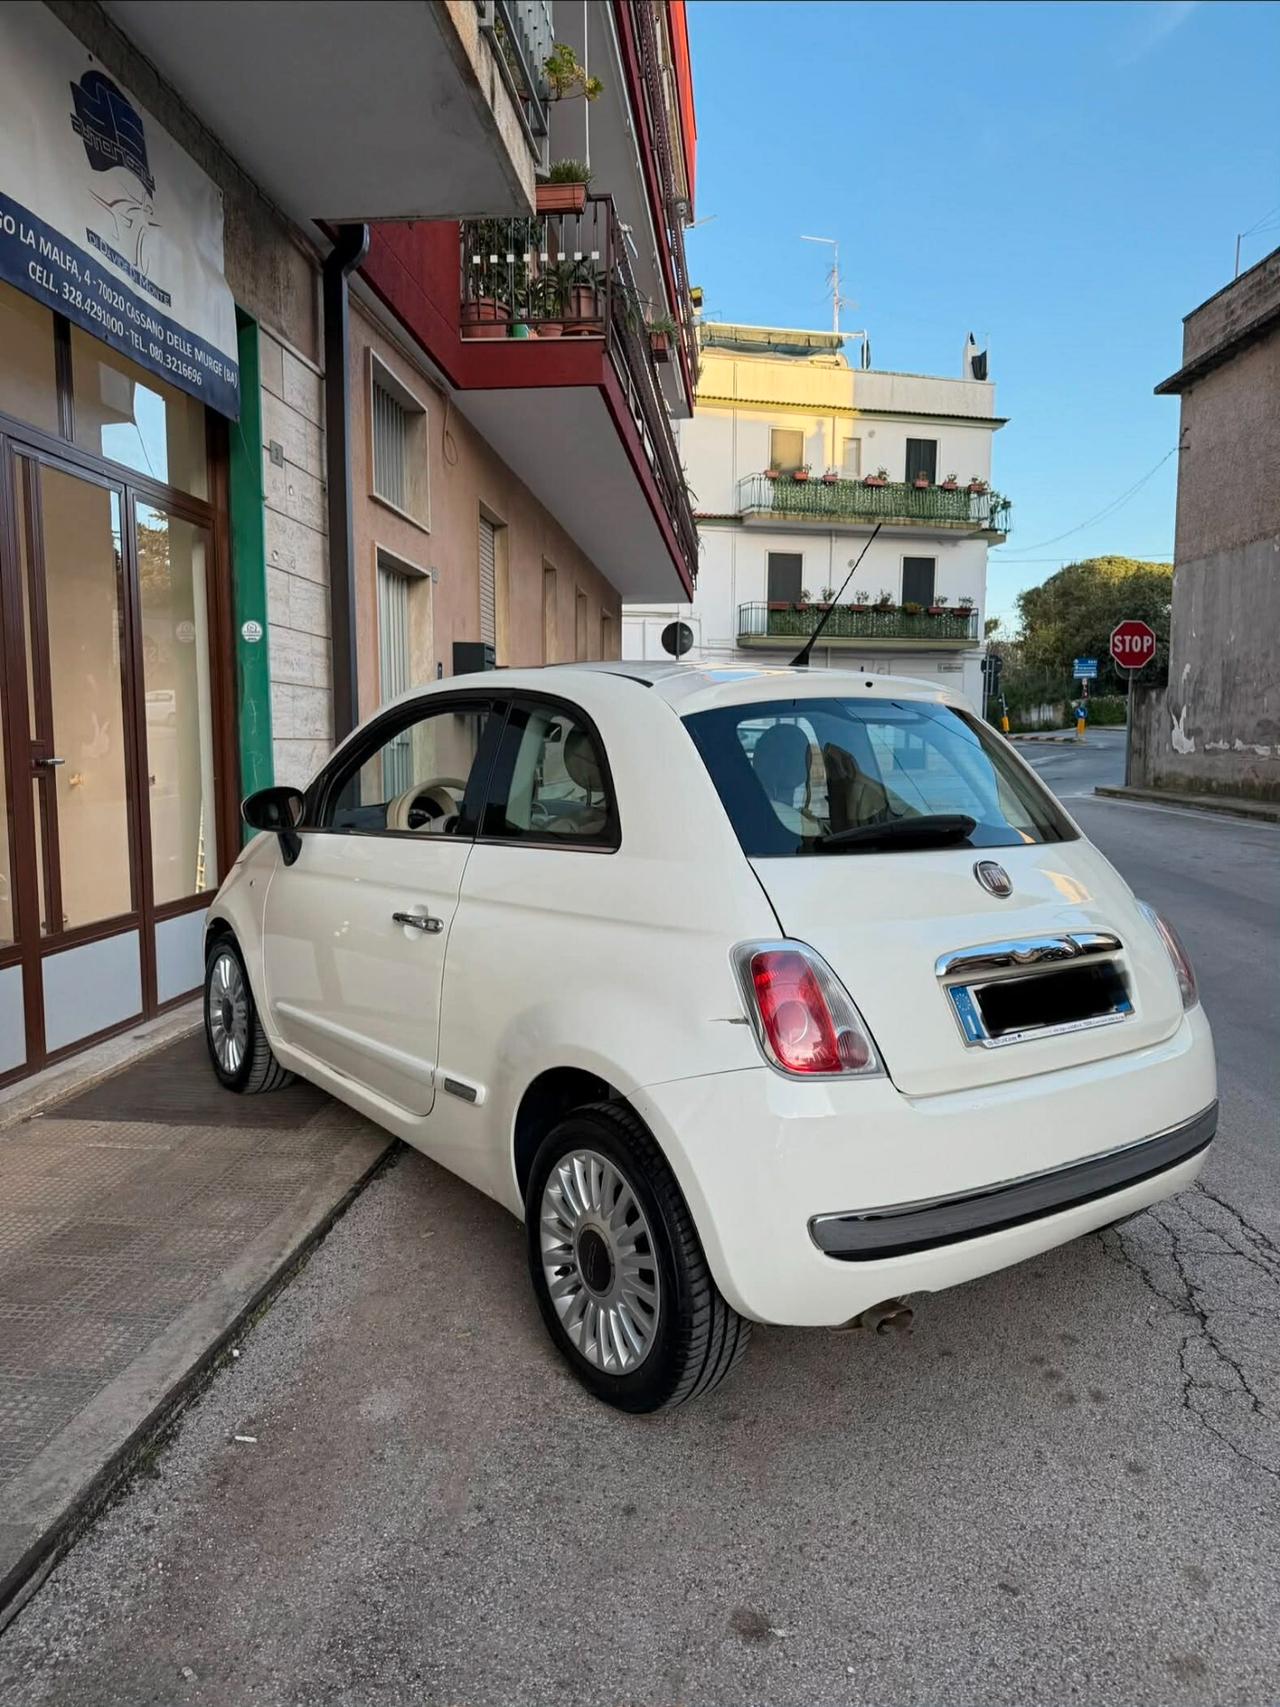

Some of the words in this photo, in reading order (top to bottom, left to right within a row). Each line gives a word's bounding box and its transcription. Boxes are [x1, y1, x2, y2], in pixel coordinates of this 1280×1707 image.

[19, 223, 36, 249] LA
[39, 236, 82, 283] MALFA,
[84, 270, 91, 286] 4
[98, 279, 124, 311] 70020
[126, 302, 164, 341] CASSANO
[166, 329, 193, 358] DELLE
[194, 348, 223, 377] MURGE
[223, 364, 238, 389] (BA)
[28, 261, 58, 294] CELL.
[62, 282, 124, 337] 328.4291000
[129, 330, 148, 353] TEL.
[149, 342, 203, 386] 080.3216696
[1114, 635, 1152, 653] STOP
